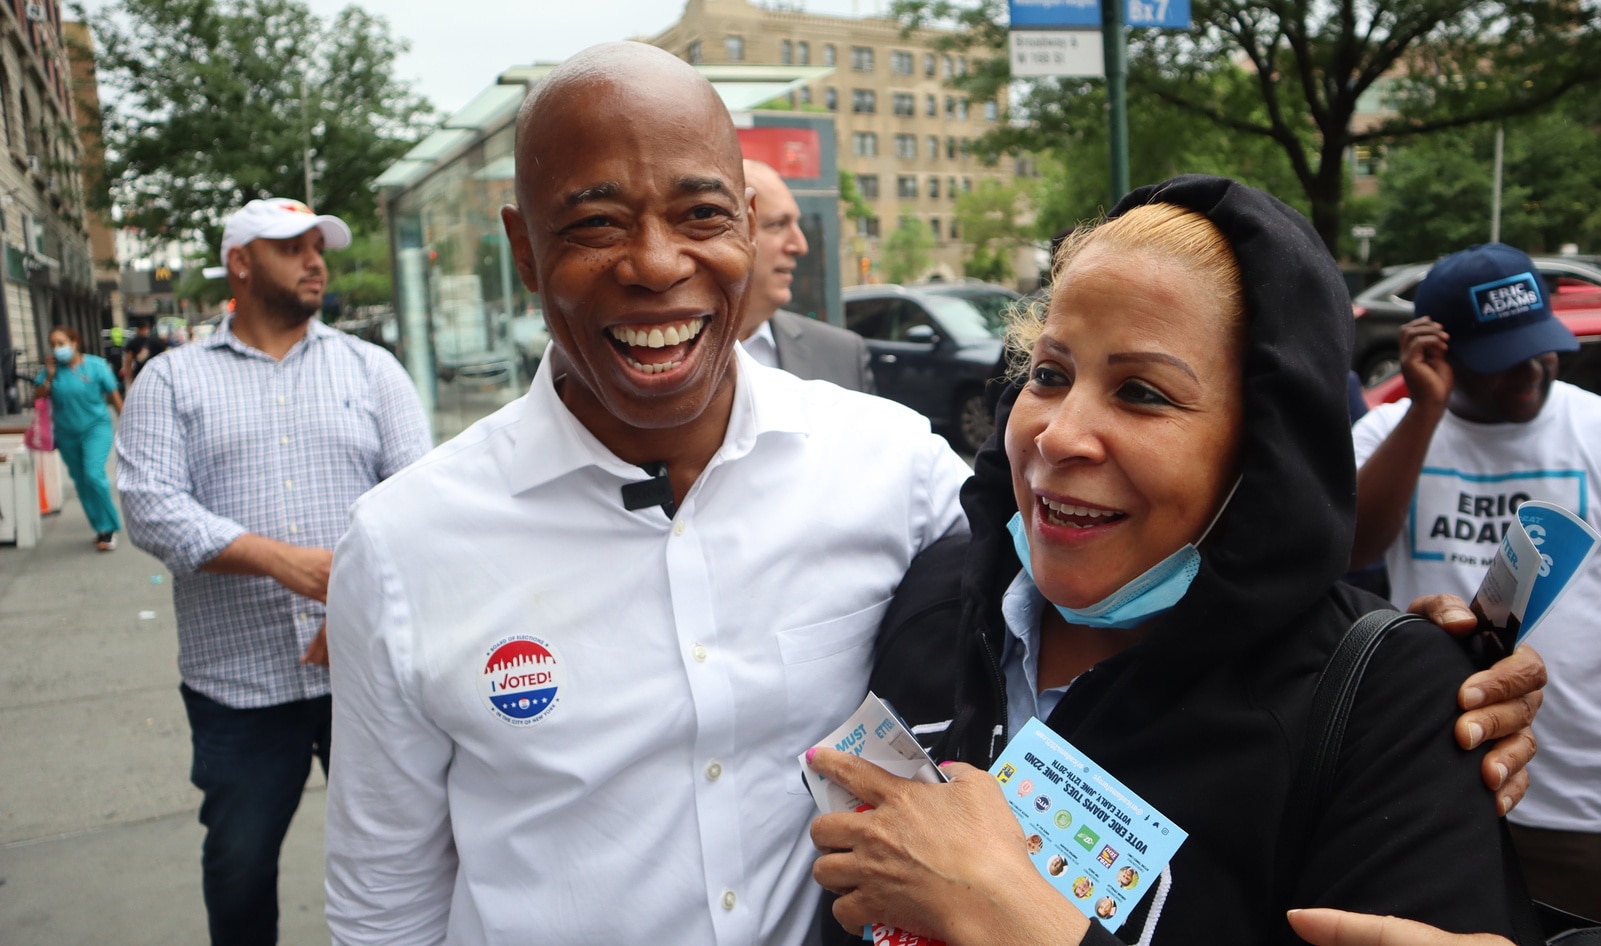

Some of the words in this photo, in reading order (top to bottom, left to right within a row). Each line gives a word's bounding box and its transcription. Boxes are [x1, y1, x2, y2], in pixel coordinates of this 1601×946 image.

[1489, 283, 1526, 300] ERIC
[1482, 291, 1538, 315] ADAMS
[1430, 515, 1512, 544] ADA
[490, 639, 506, 651] BOARD
[516, 635, 545, 645] ELECTIONS
[491, 681, 496, 692] I
[835, 723, 868, 751] MUST
[1024, 752, 1045, 771] 22ND
[1042, 766, 1063, 785] JUNE
[1051, 759, 1081, 786] 12TH-20TH
[1063, 780, 1083, 803] TUES,
[1080, 782, 1097, 796] JUNE
[1082, 798, 1110, 823] ADAMS
[1096, 793, 1116, 813] EARLY,
[1114, 809, 1131, 825] VOTE
[1107, 818, 1128, 838] ERIC
[1124, 832, 1148, 854] VOTE
